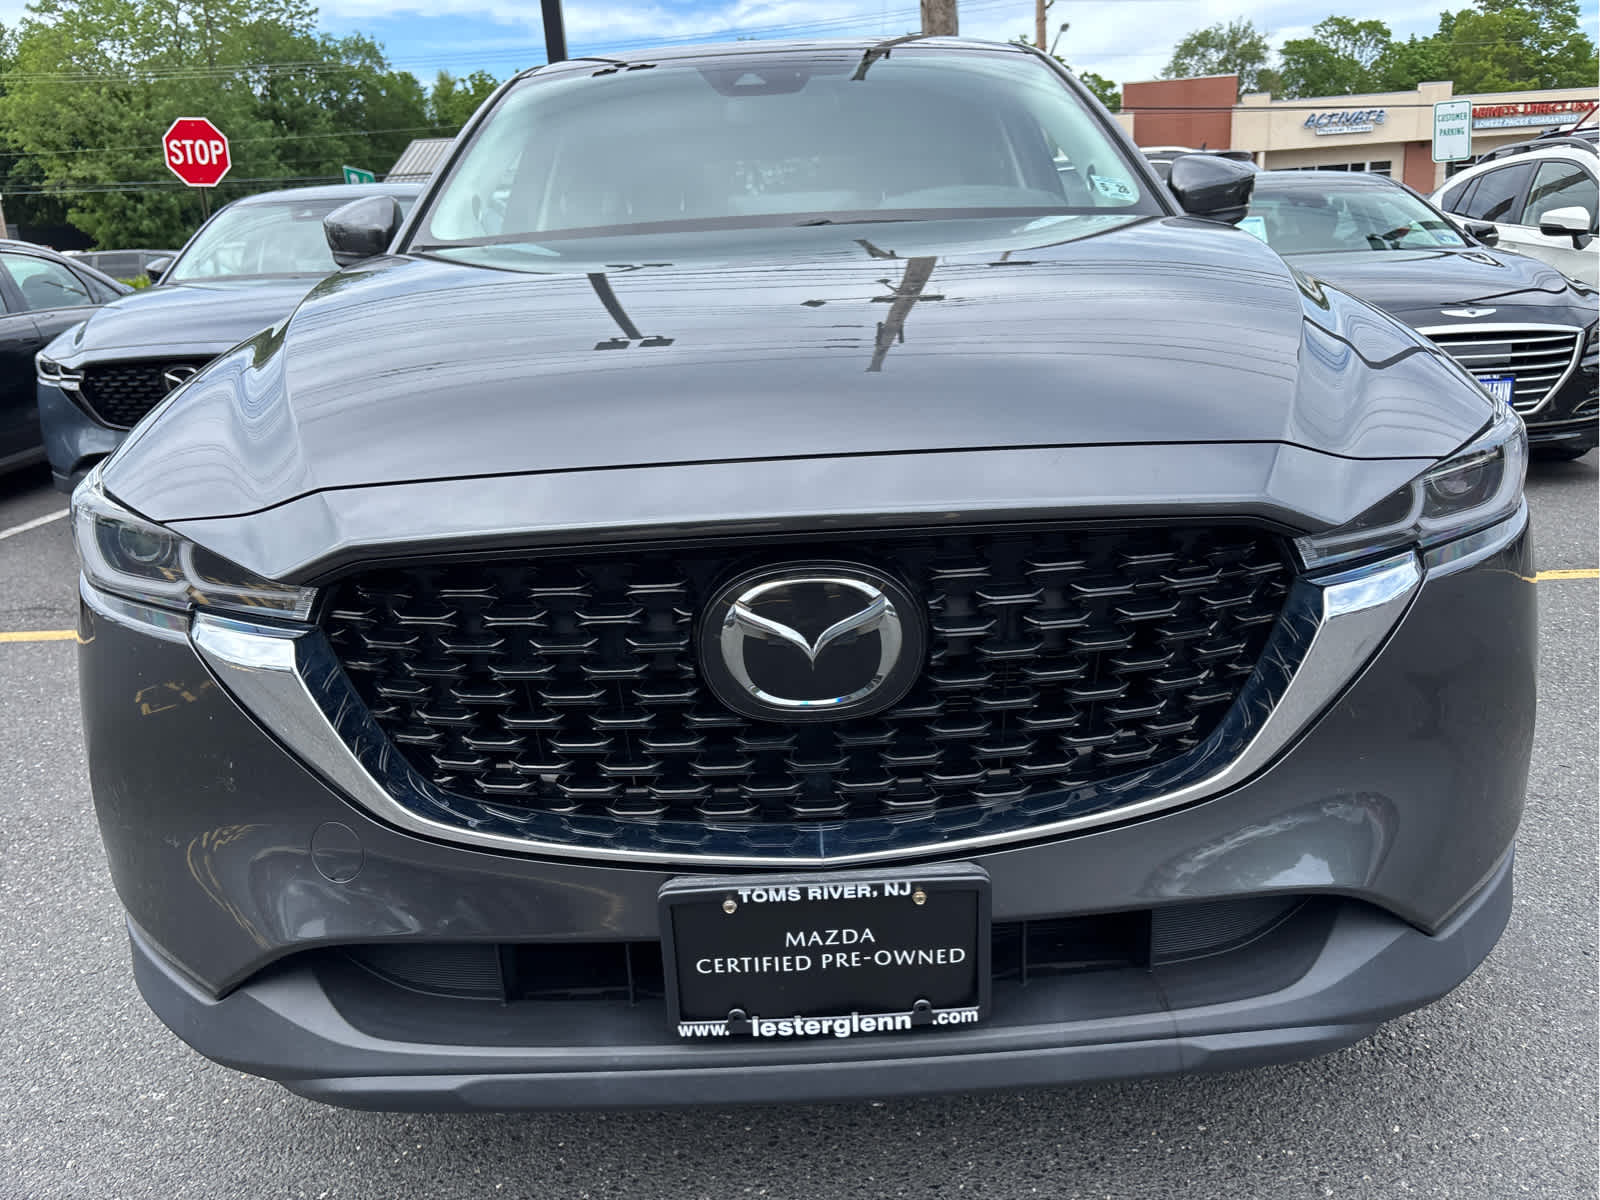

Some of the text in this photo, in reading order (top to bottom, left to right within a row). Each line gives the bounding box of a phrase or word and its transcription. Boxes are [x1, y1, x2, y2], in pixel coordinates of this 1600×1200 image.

[1438, 112, 1467, 122] CUSTOMER
[1472, 104, 1520, 117] ABINETS
[1571, 101, 1594, 112] USA
[1304, 110, 1385, 128] ACTIVATE
[1439, 127, 1465, 137] PARKING
[169, 139, 224, 165] STOP
[738, 881, 912, 903] TOMS RIVER, NJ
[785, 928, 875, 947] MAZDA
[696, 948, 966, 974] CERTIFIED PRE-OWNED
[678, 1023, 729, 1037] www.
[752, 1011, 912, 1038] lesterglenn
